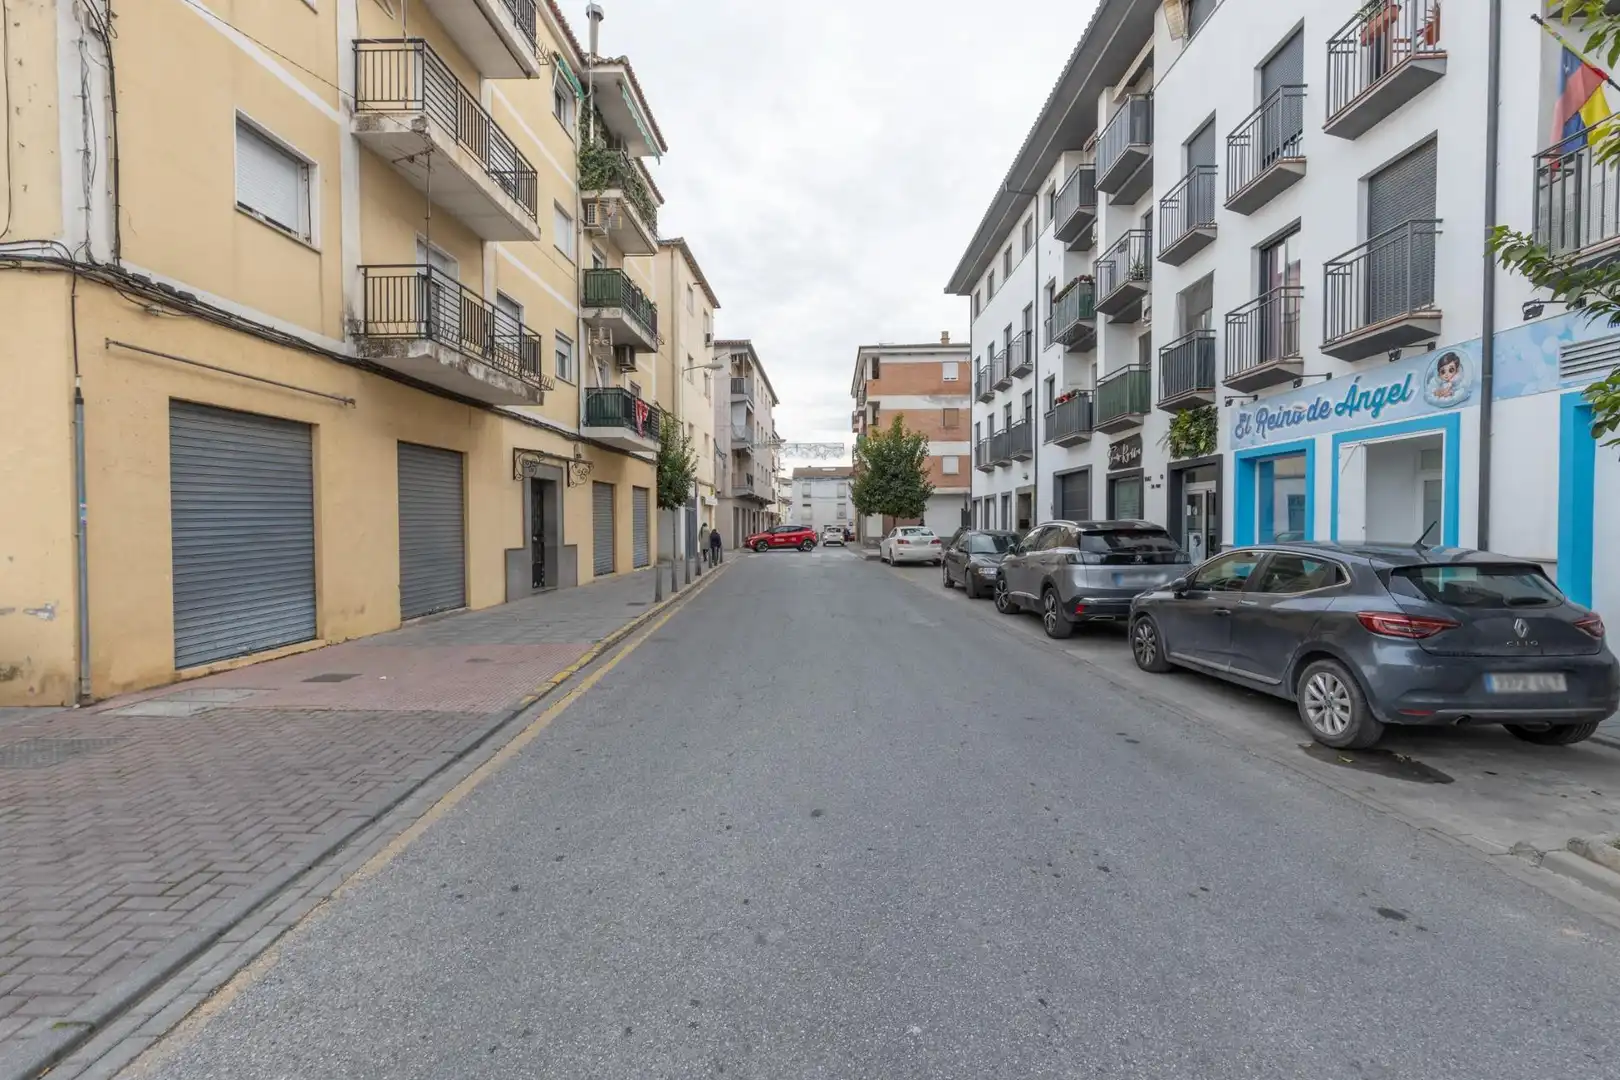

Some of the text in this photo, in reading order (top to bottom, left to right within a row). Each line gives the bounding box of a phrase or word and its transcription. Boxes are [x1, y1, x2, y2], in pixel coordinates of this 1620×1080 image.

[1235, 373, 1414, 439] El Reino de Ángel
[1506, 640, 1539, 648] CLIO
